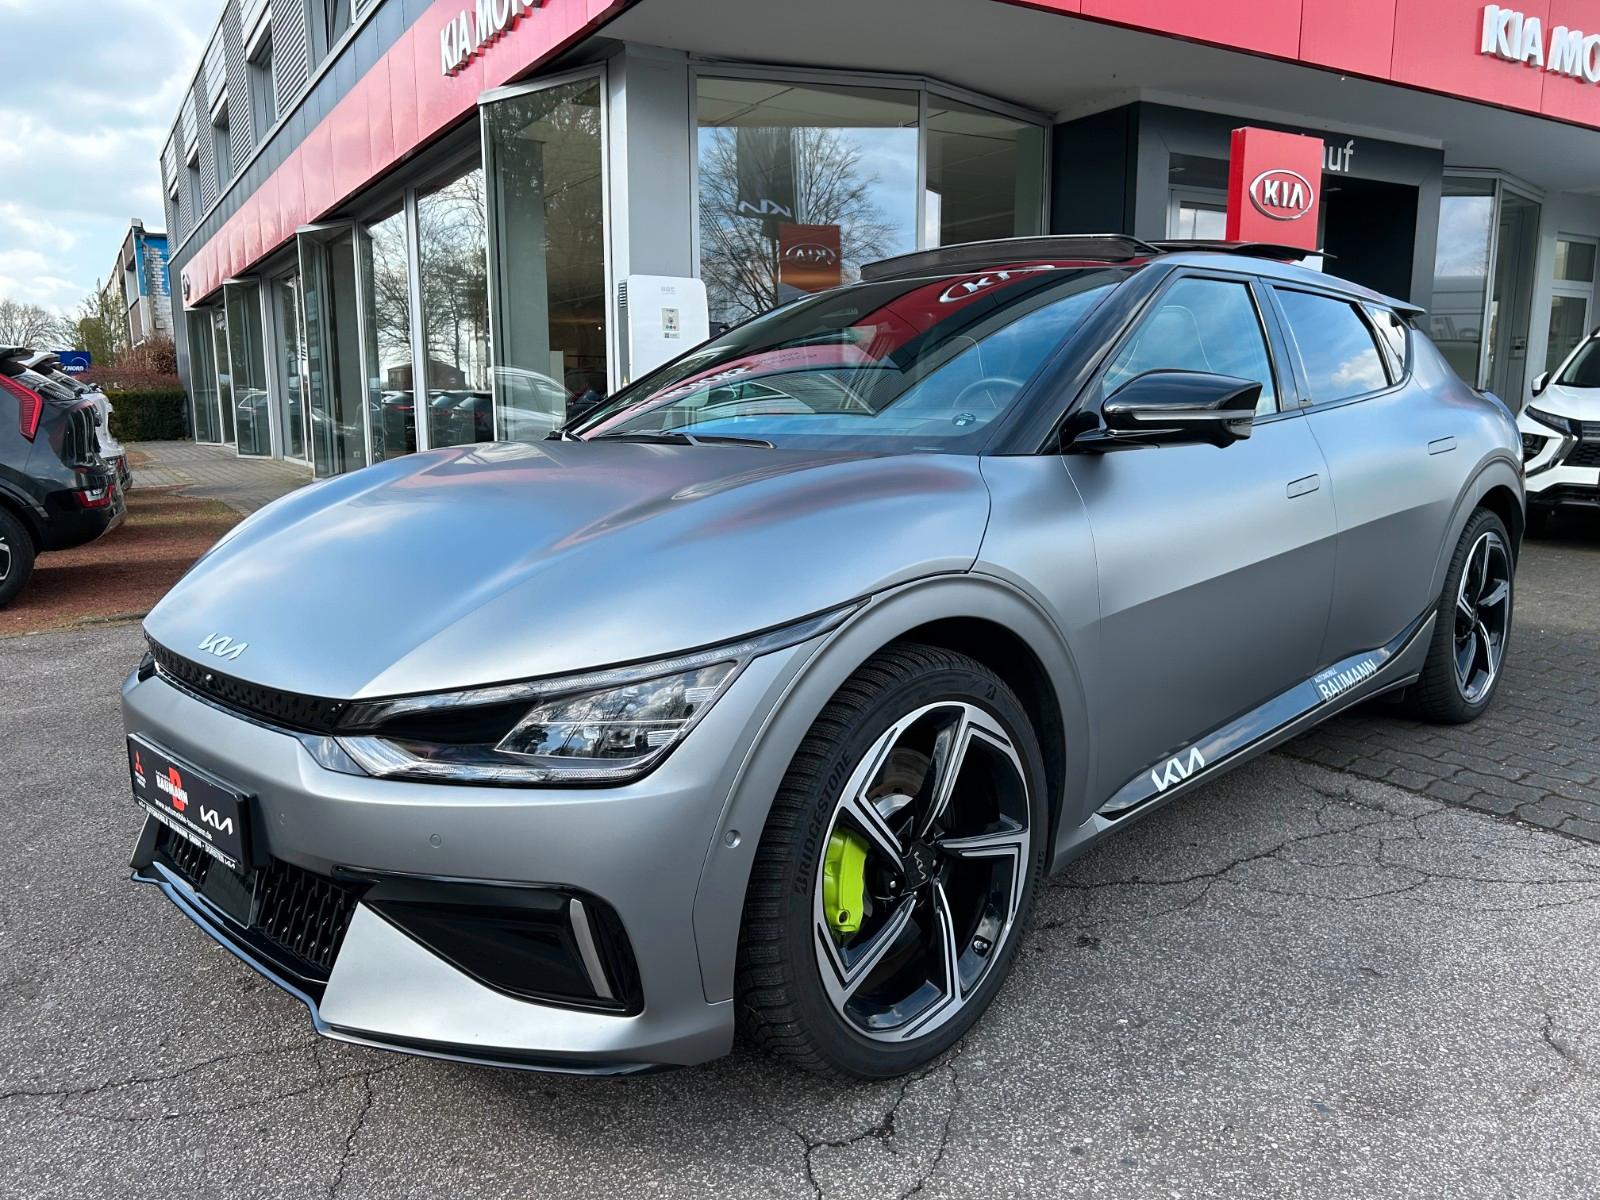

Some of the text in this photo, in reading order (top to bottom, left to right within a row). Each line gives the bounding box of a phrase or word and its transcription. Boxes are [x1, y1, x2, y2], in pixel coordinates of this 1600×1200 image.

[440, 9, 471, 76] KIA
[1481, 4, 1544, 66] KIA
[1264, 179, 1304, 209] KIA
[198, 632, 249, 661] KIA
[1318, 659, 1377, 700] BAUMANN
[1151, 747, 1205, 792] KIA
[200, 804, 233, 835] KIA
